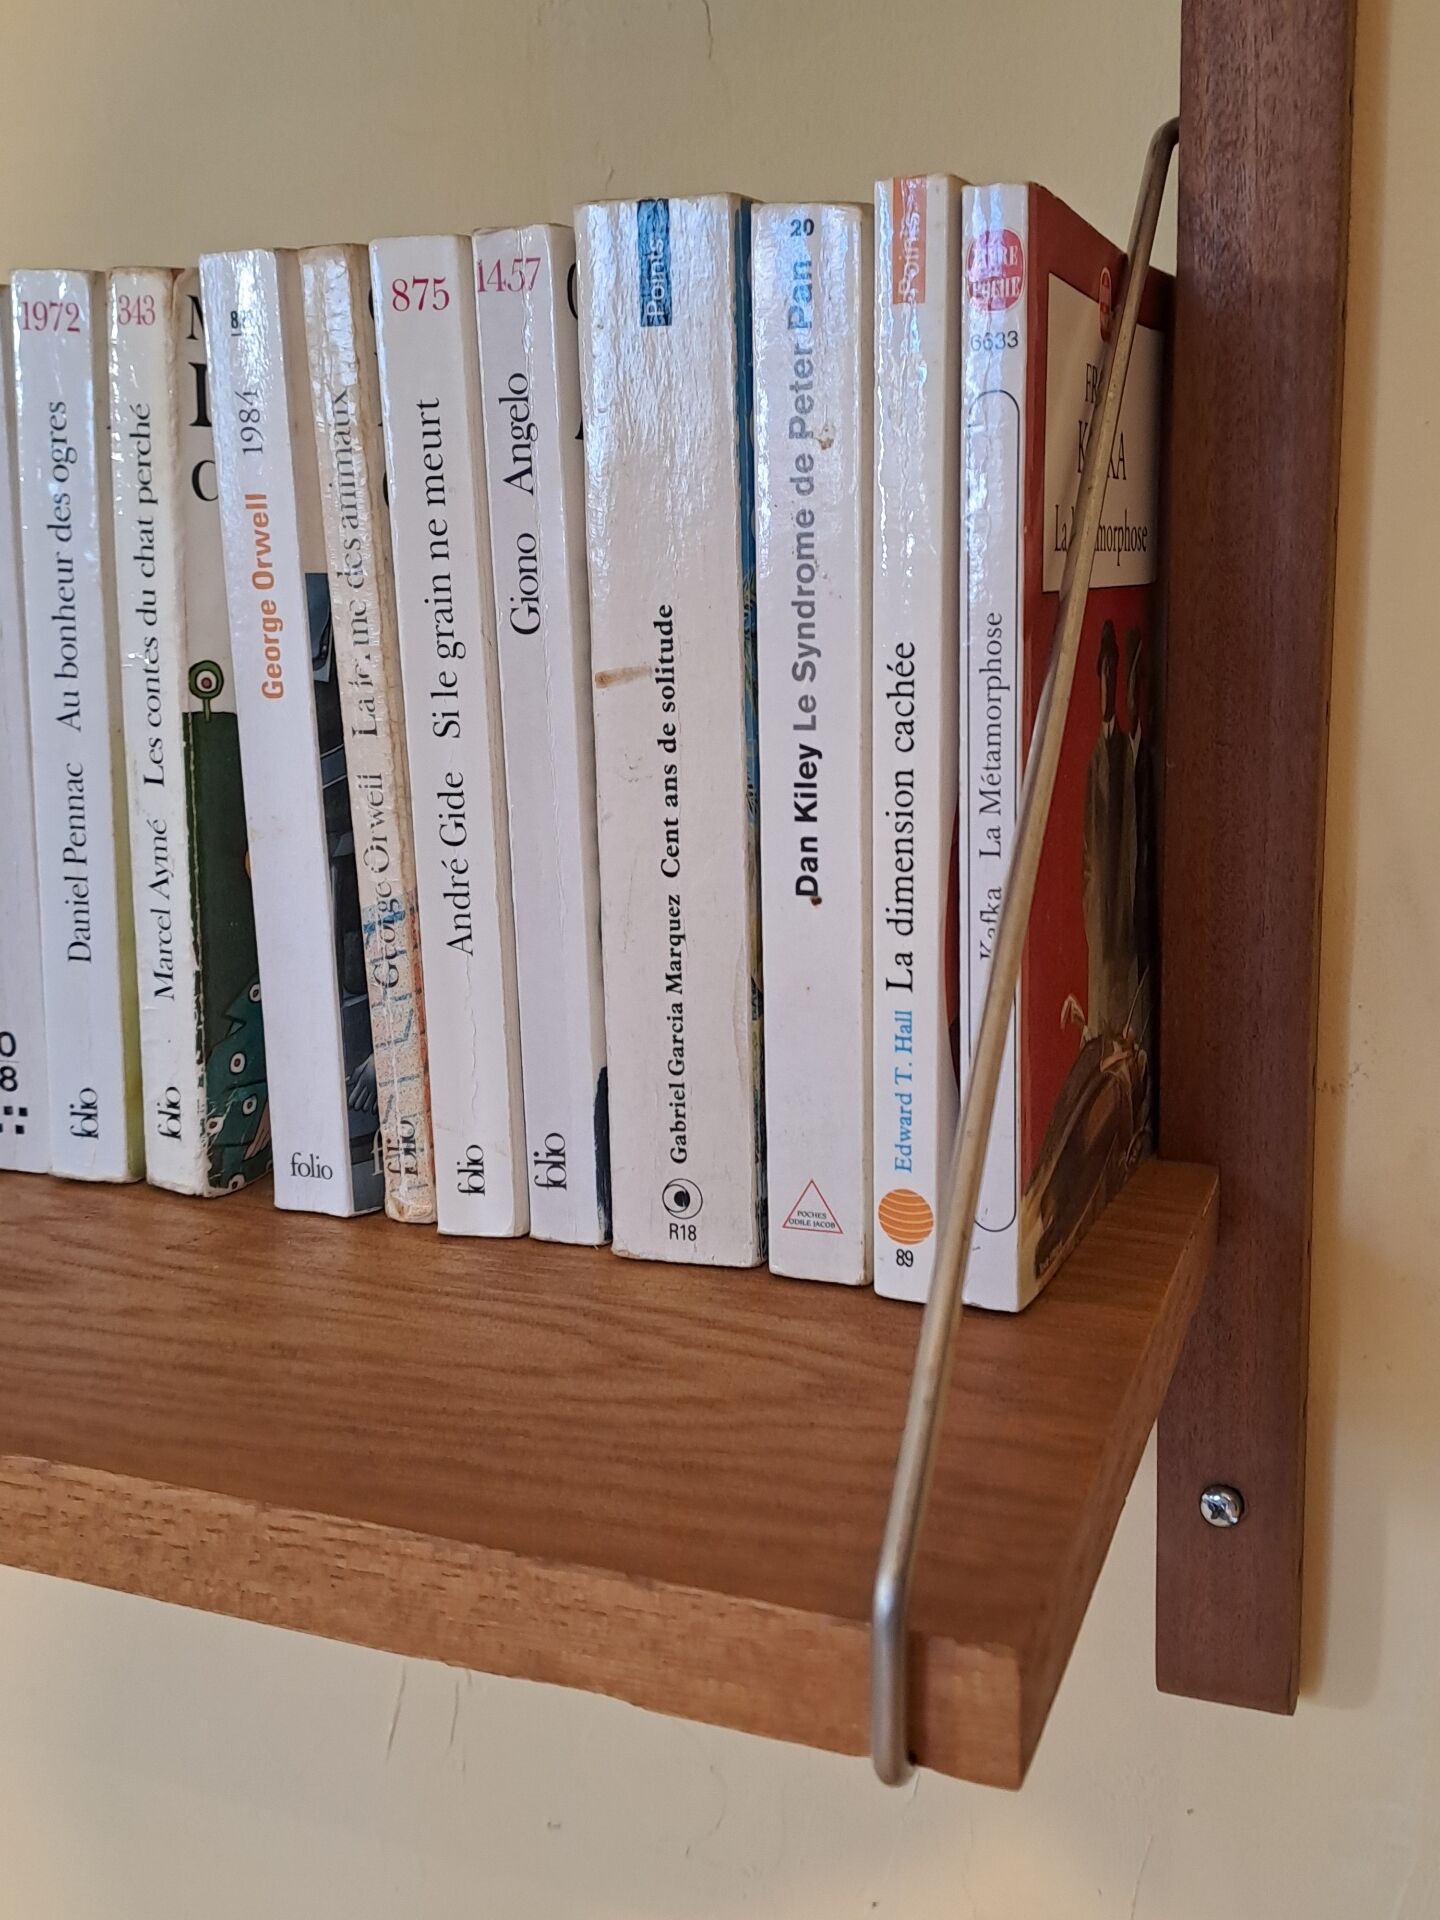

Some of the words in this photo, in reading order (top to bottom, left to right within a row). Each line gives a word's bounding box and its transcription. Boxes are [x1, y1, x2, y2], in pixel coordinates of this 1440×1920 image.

[790, 217, 815, 237] 20
[391, 275, 450, 312] 875
[477, 257, 542, 293] 1457
[787, 260, 812, 330] Pan
[21, 300, 81, 334] 1972
[118, 294, 156, 326] 343
[234, 388, 264, 455] 1984
[788, 343, 815, 439] Peter
[49, 401, 77, 483] ogres
[129, 403, 159, 505] perché
[328, 387, 359, 529] animaux
[416, 397, 446, 506] meurt
[498, 372, 539, 496] Angelo
[790, 453, 815, 496] de
[47, 492, 73, 542] des
[133, 516, 155, 578] chat
[245, 494, 276, 589] Orwell
[428, 518, 450, 561] ne
[1054, 504, 1068, 551] La
[135, 589, 158, 626] du
[509, 532, 541, 635] Giono
[791, 509, 821, 683] Syndrome
[51, 551, 79, 679] bonheur
[424, 573, 466, 659] grain
[260, 598, 284, 701] George
[653, 603, 676, 712] solitude
[56, 690, 82, 732] Au
[142, 636, 162, 727] contes
[430, 671, 458, 699] le
[886, 641, 915, 753] cachée
[352, 698, 378, 737] La
[432, 710, 461, 738] Si
[657, 723, 677, 753] de
[793, 694, 817, 731] Le
[978, 612, 1010, 815] Métamorphose
[143, 737, 165, 787] Les
[663, 763, 679, 808] ans
[793, 743, 823, 822] Kiley
[63, 762, 87, 866] Pennac
[437, 772, 468, 847] Gide
[146, 818, 174, 900] Aymé
[660, 816, 681, 878] Cent
[795, 836, 819, 896] Dan
[885, 769, 914, 936] dimension
[979, 826, 1001, 859] La
[64, 875, 92, 963] Daniel
[441, 858, 474, 956] André
[150, 908, 175, 1001] Marcel
[665, 894, 686, 995] Marquez
[886, 951, 913, 992] La
[666, 1002, 685, 1077] Garcia
[894, 1010, 913, 1054] Hall
[894, 1063, 913, 1085] T.
[69, 1087, 99, 1140] folio
[156, 1086, 182, 1141] folio
[668, 1082, 688, 1164] Gabriel
[894, 1092, 913, 1173] Edward
[290, 1152, 333, 1180] folio
[457, 1144, 486, 1197] folio
[533, 1132, 567, 1191] folio
[669, 1223, 697, 1241] R18
[788, 1218, 811, 1226] ODILE
[813, 1220, 836, 1229] JACOB
[797, 1210, 827, 1219] POCHES
[896, 1248, 914, 1267] 89
